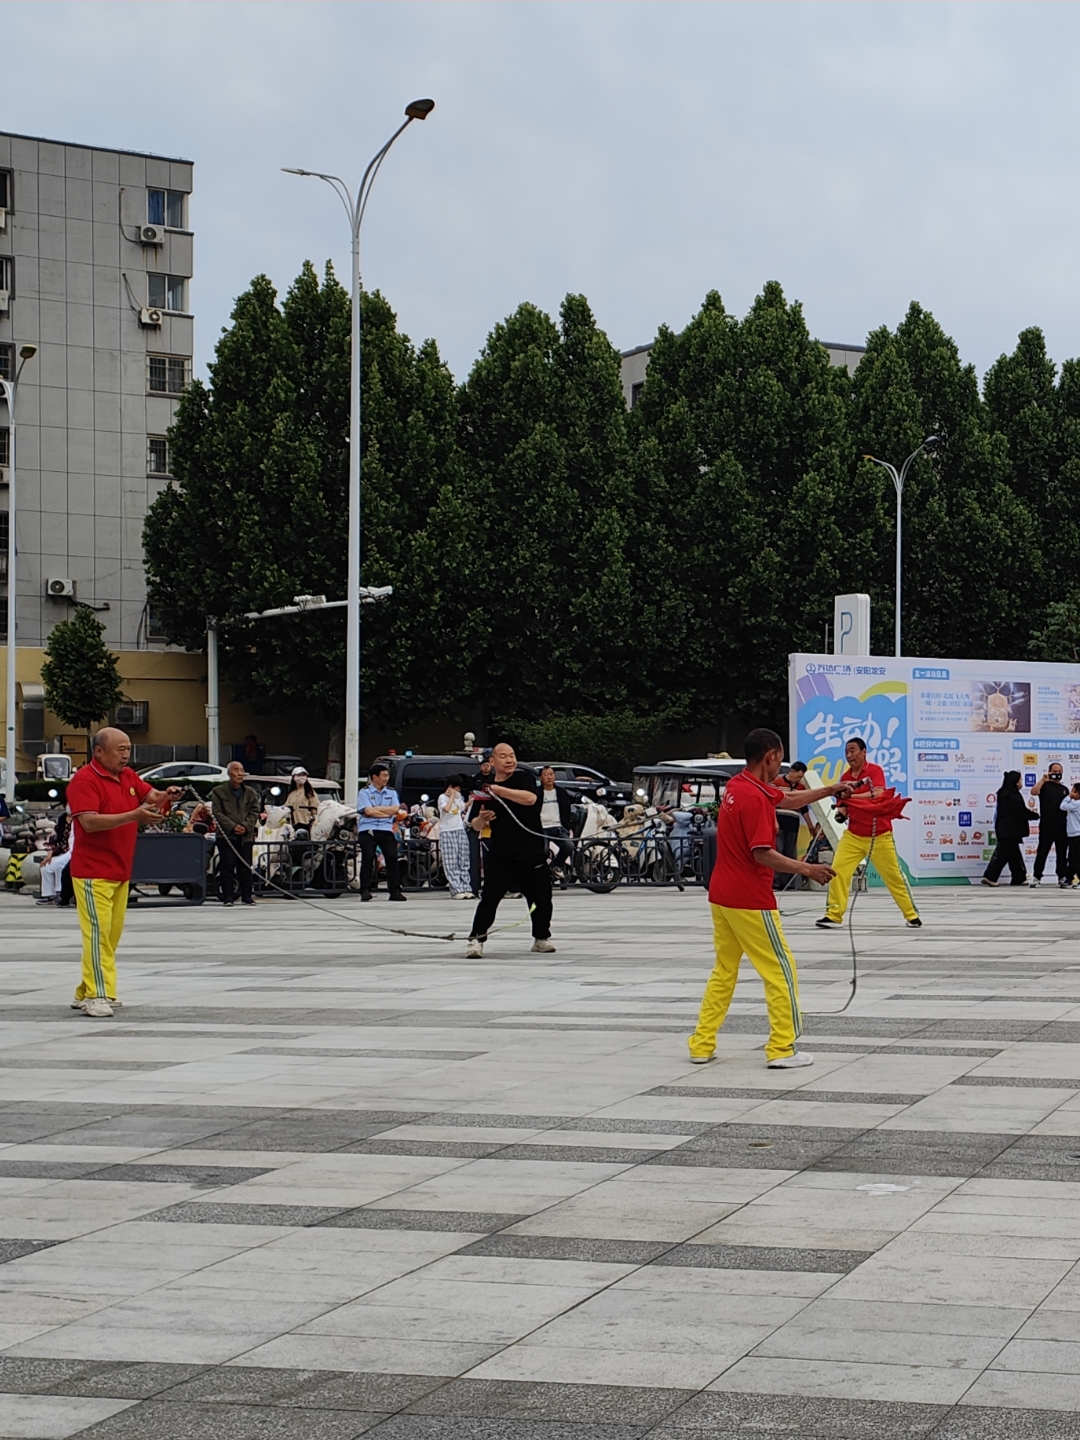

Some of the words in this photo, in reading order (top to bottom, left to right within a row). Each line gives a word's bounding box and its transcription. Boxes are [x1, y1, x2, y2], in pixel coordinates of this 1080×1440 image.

[817, 663, 852, 672] 万达广场
[855, 666, 886, 676] 安阳龙安
[805, 711, 900, 755] 生动!
[806, 755, 850, 787] FU
